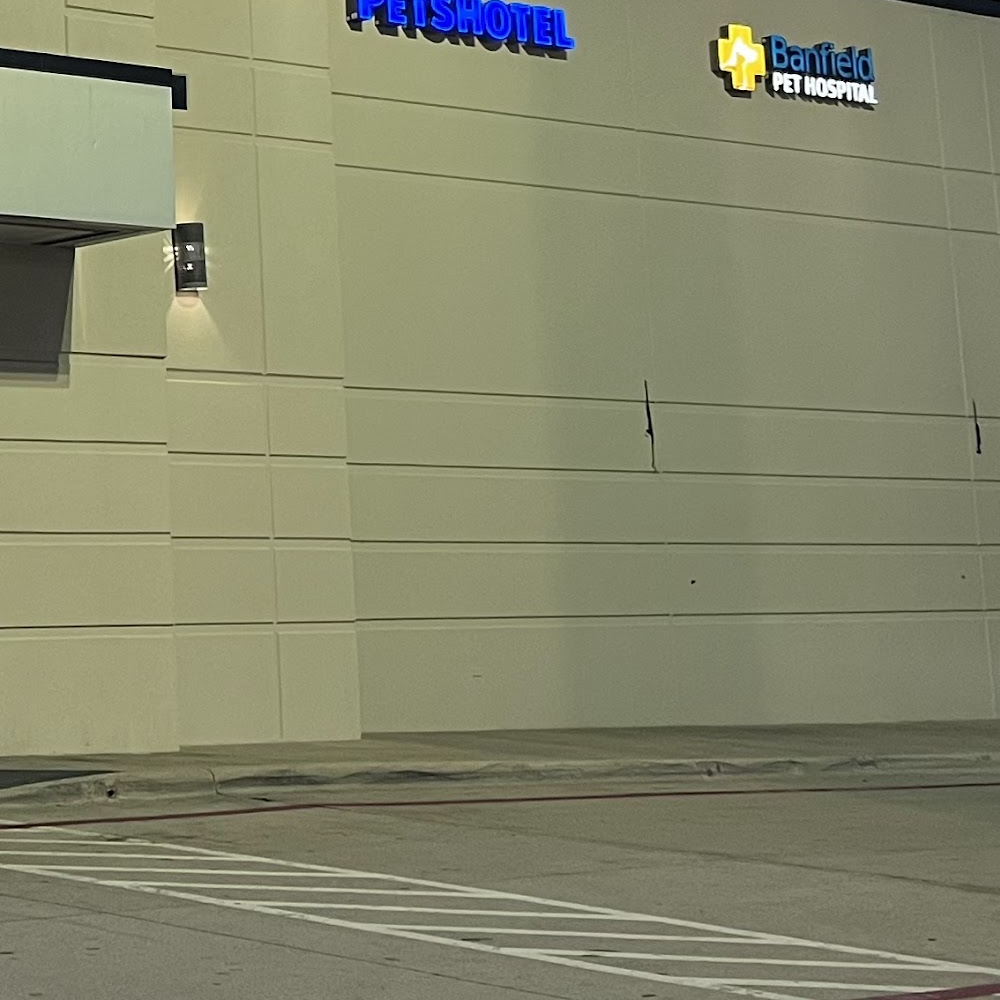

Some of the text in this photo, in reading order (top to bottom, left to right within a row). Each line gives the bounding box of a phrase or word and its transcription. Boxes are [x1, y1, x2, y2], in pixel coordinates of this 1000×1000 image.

[770, 35, 875, 82] Banfield
[772, 71, 879, 105] PET HOSPITAL
